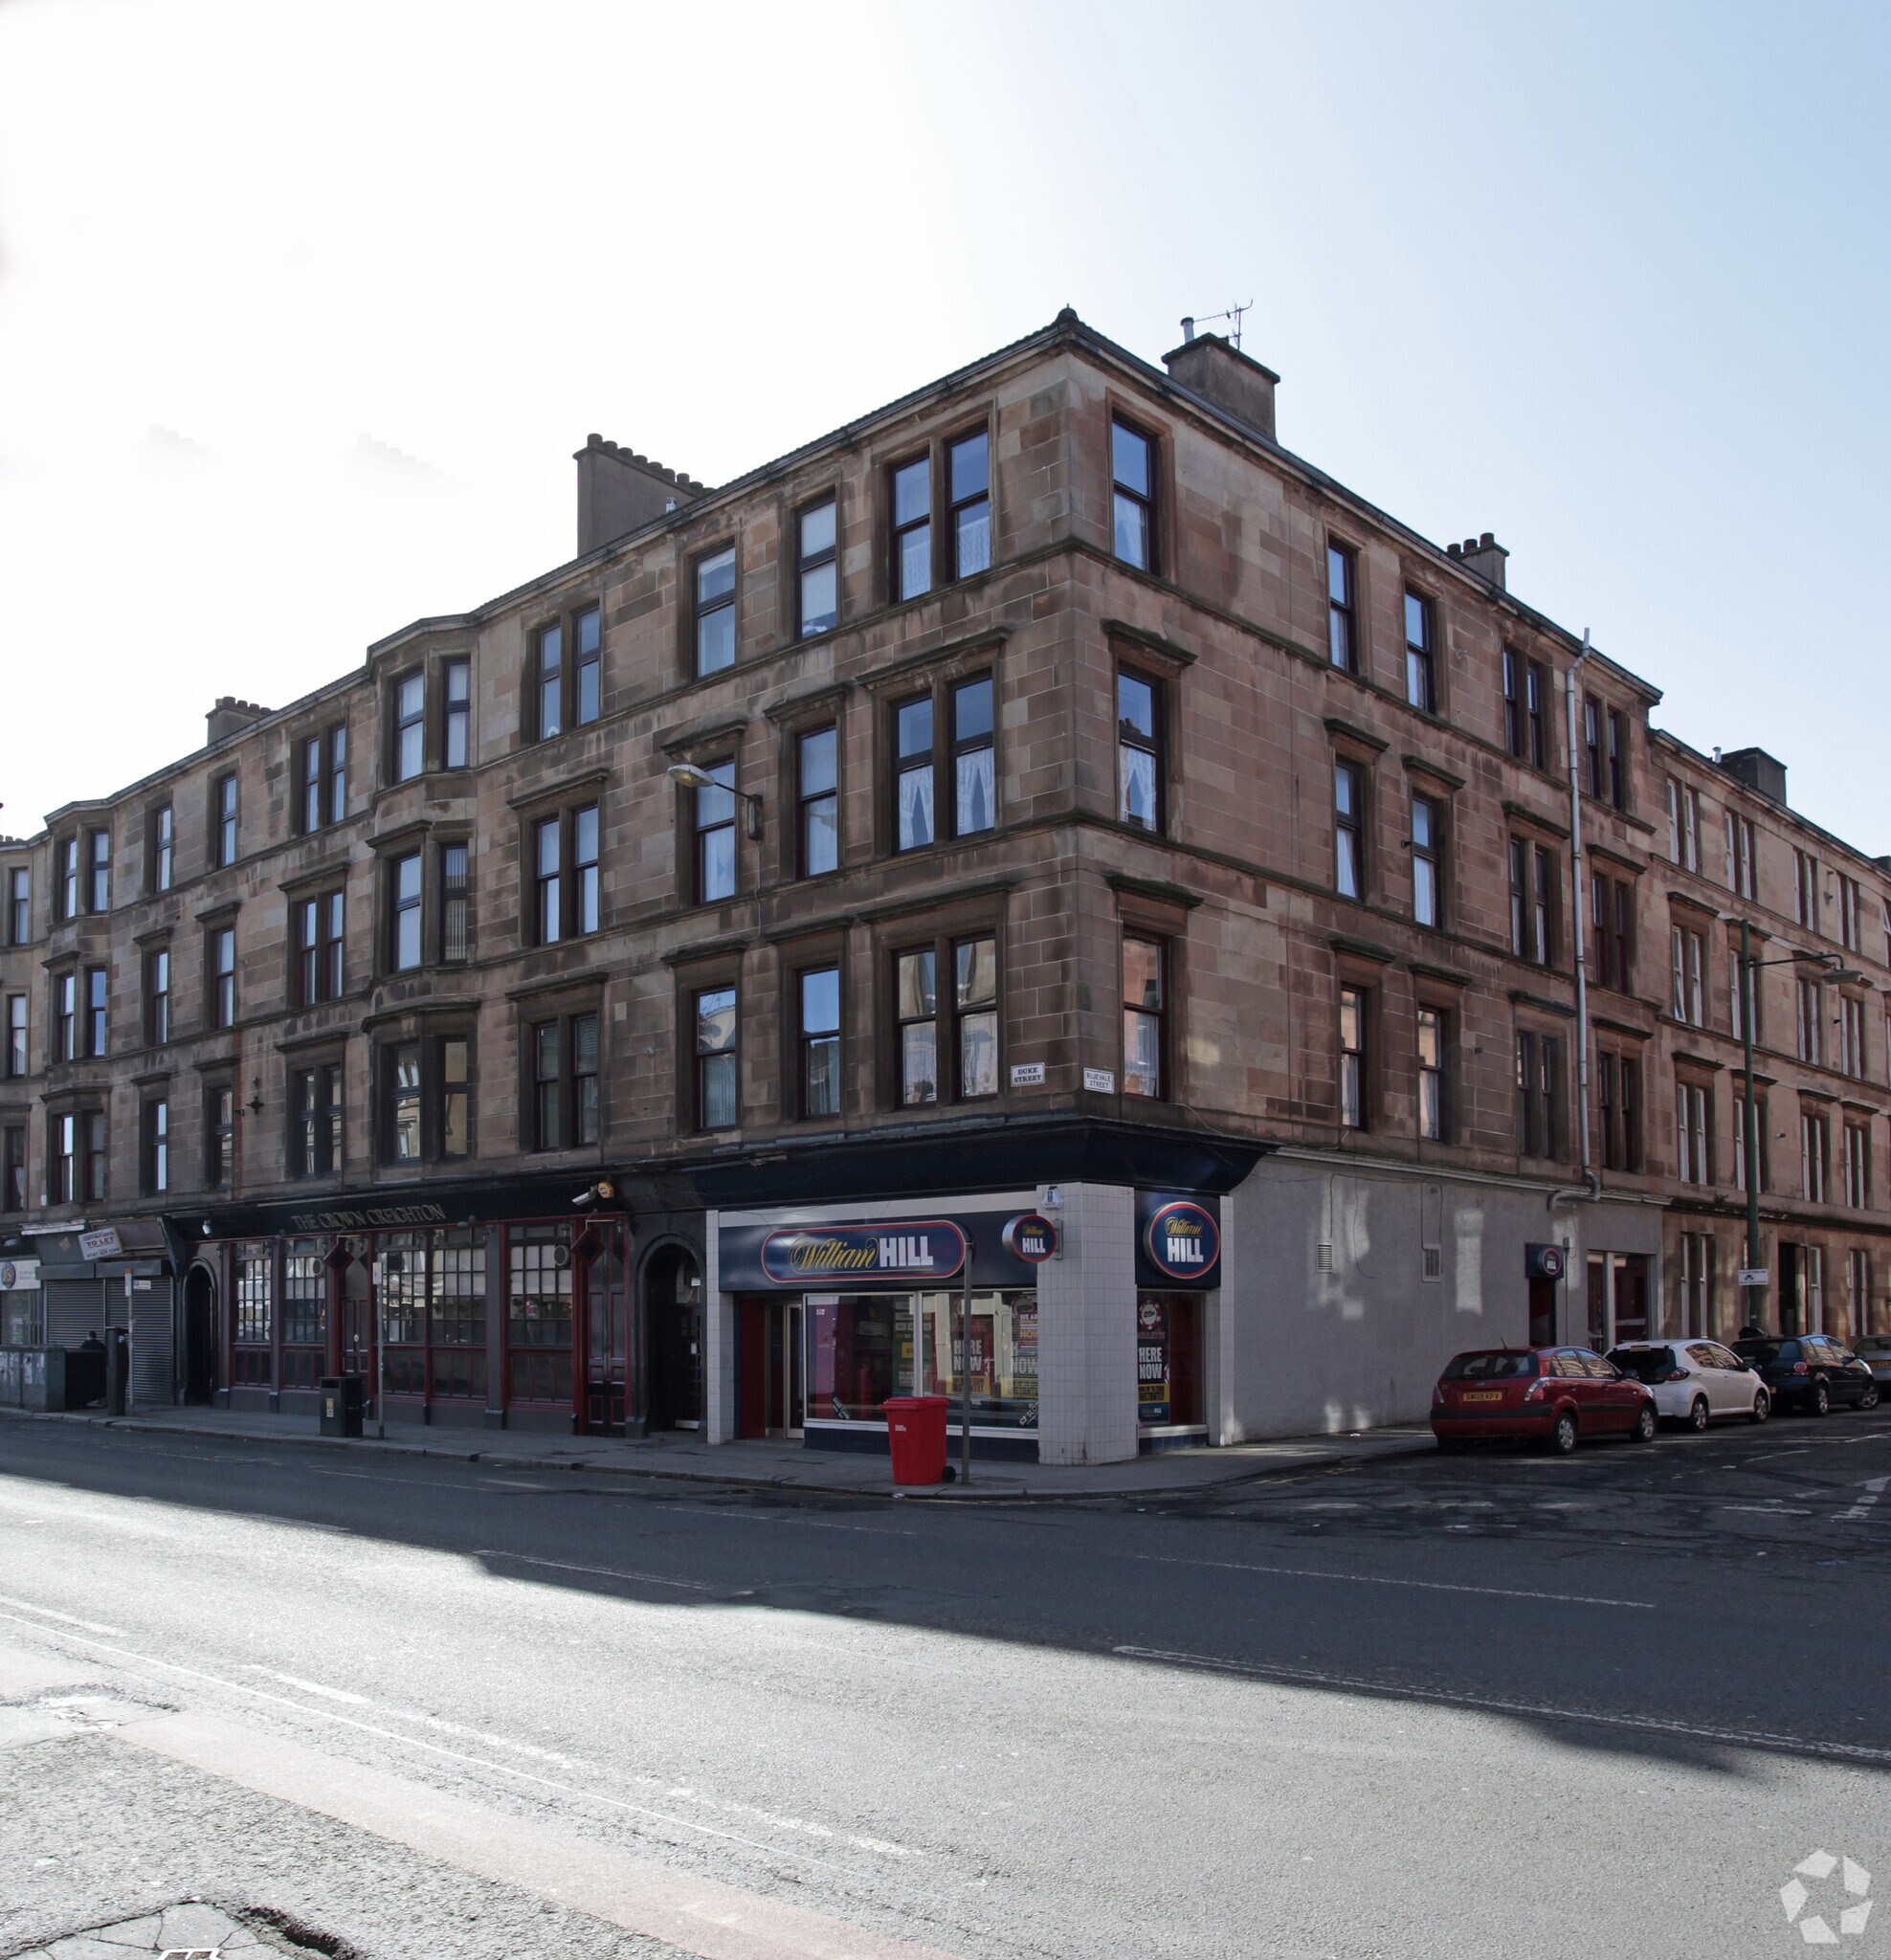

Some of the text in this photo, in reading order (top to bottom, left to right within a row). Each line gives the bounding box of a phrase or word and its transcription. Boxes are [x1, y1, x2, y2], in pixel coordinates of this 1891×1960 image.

[1013, 1075, 1042, 1083] STREET
[1086, 1072, 1111, 1082] BLUEVALE
[1089, 1080, 1109, 1089] STREET
[291, 1204, 446, 1230] THE CROWN CREIGHTON
[1165, 1216, 1204, 1236] William
[1022, 1237, 1046, 1253] HILL
[1167, 1236, 1204, 1262] HILL
[788, 1236, 934, 1273] William HILL
[953, 1355, 983, 1371] NW
[1138, 1347, 1163, 1363] HERE
[1138, 1363, 1163, 1380] NOW
